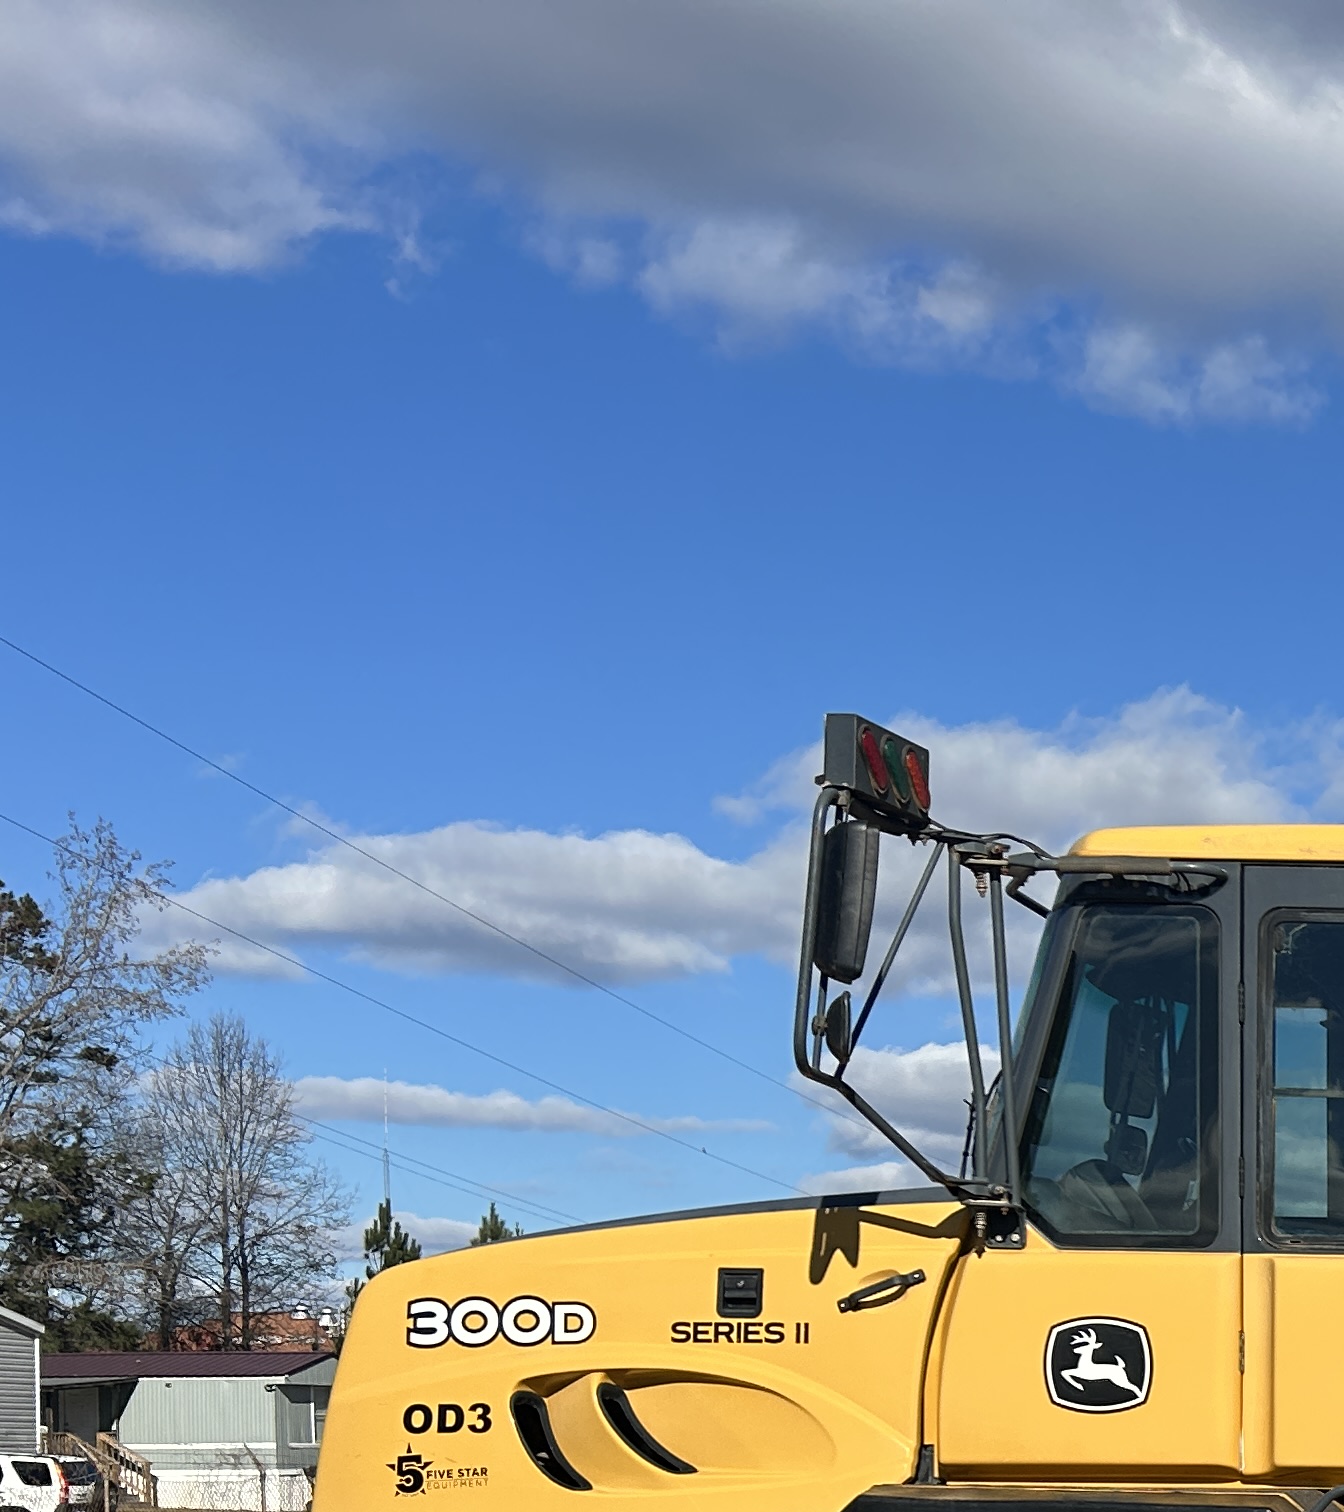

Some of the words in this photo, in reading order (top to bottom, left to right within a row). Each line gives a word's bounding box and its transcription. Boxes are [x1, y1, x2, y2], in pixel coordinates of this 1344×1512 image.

[406, 1294, 597, 1349] 300D
[670, 1321, 786, 1344] SERIES
[795, 1322, 809, 1344] II
[403, 1402, 493, 1434] OD3
[395, 1454, 424, 1494] 5
[426, 1469, 454, 1480] FIVE
[457, 1467, 489, 1479] STAR
[426, 1478, 489, 1490] EQUIPMENT
